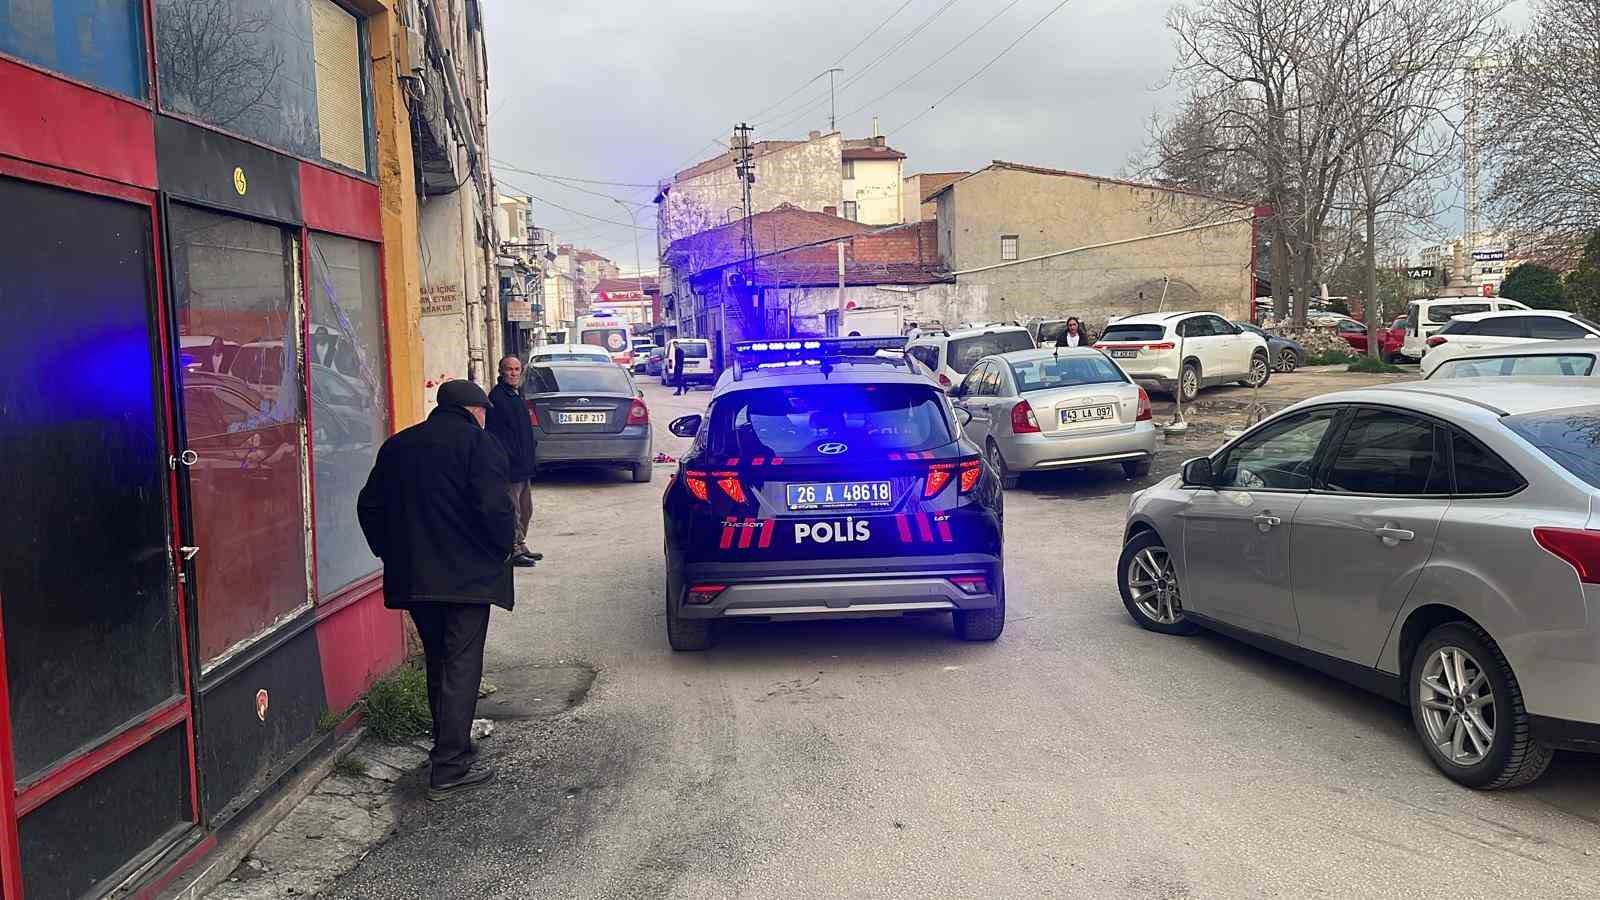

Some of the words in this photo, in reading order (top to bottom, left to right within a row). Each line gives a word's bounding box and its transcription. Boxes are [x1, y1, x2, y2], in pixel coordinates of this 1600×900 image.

[1408, 269, 1432, 278] YAPI
[1068, 410, 1077, 419] 43
[1082, 409, 1092, 418] LA
[1096, 406, 1111, 417] 097
[797, 486, 815, 503] 26
[825, 485, 834, 502] A
[843, 483, 889, 501] 48618
[795, 517, 870, 544] POLİS
